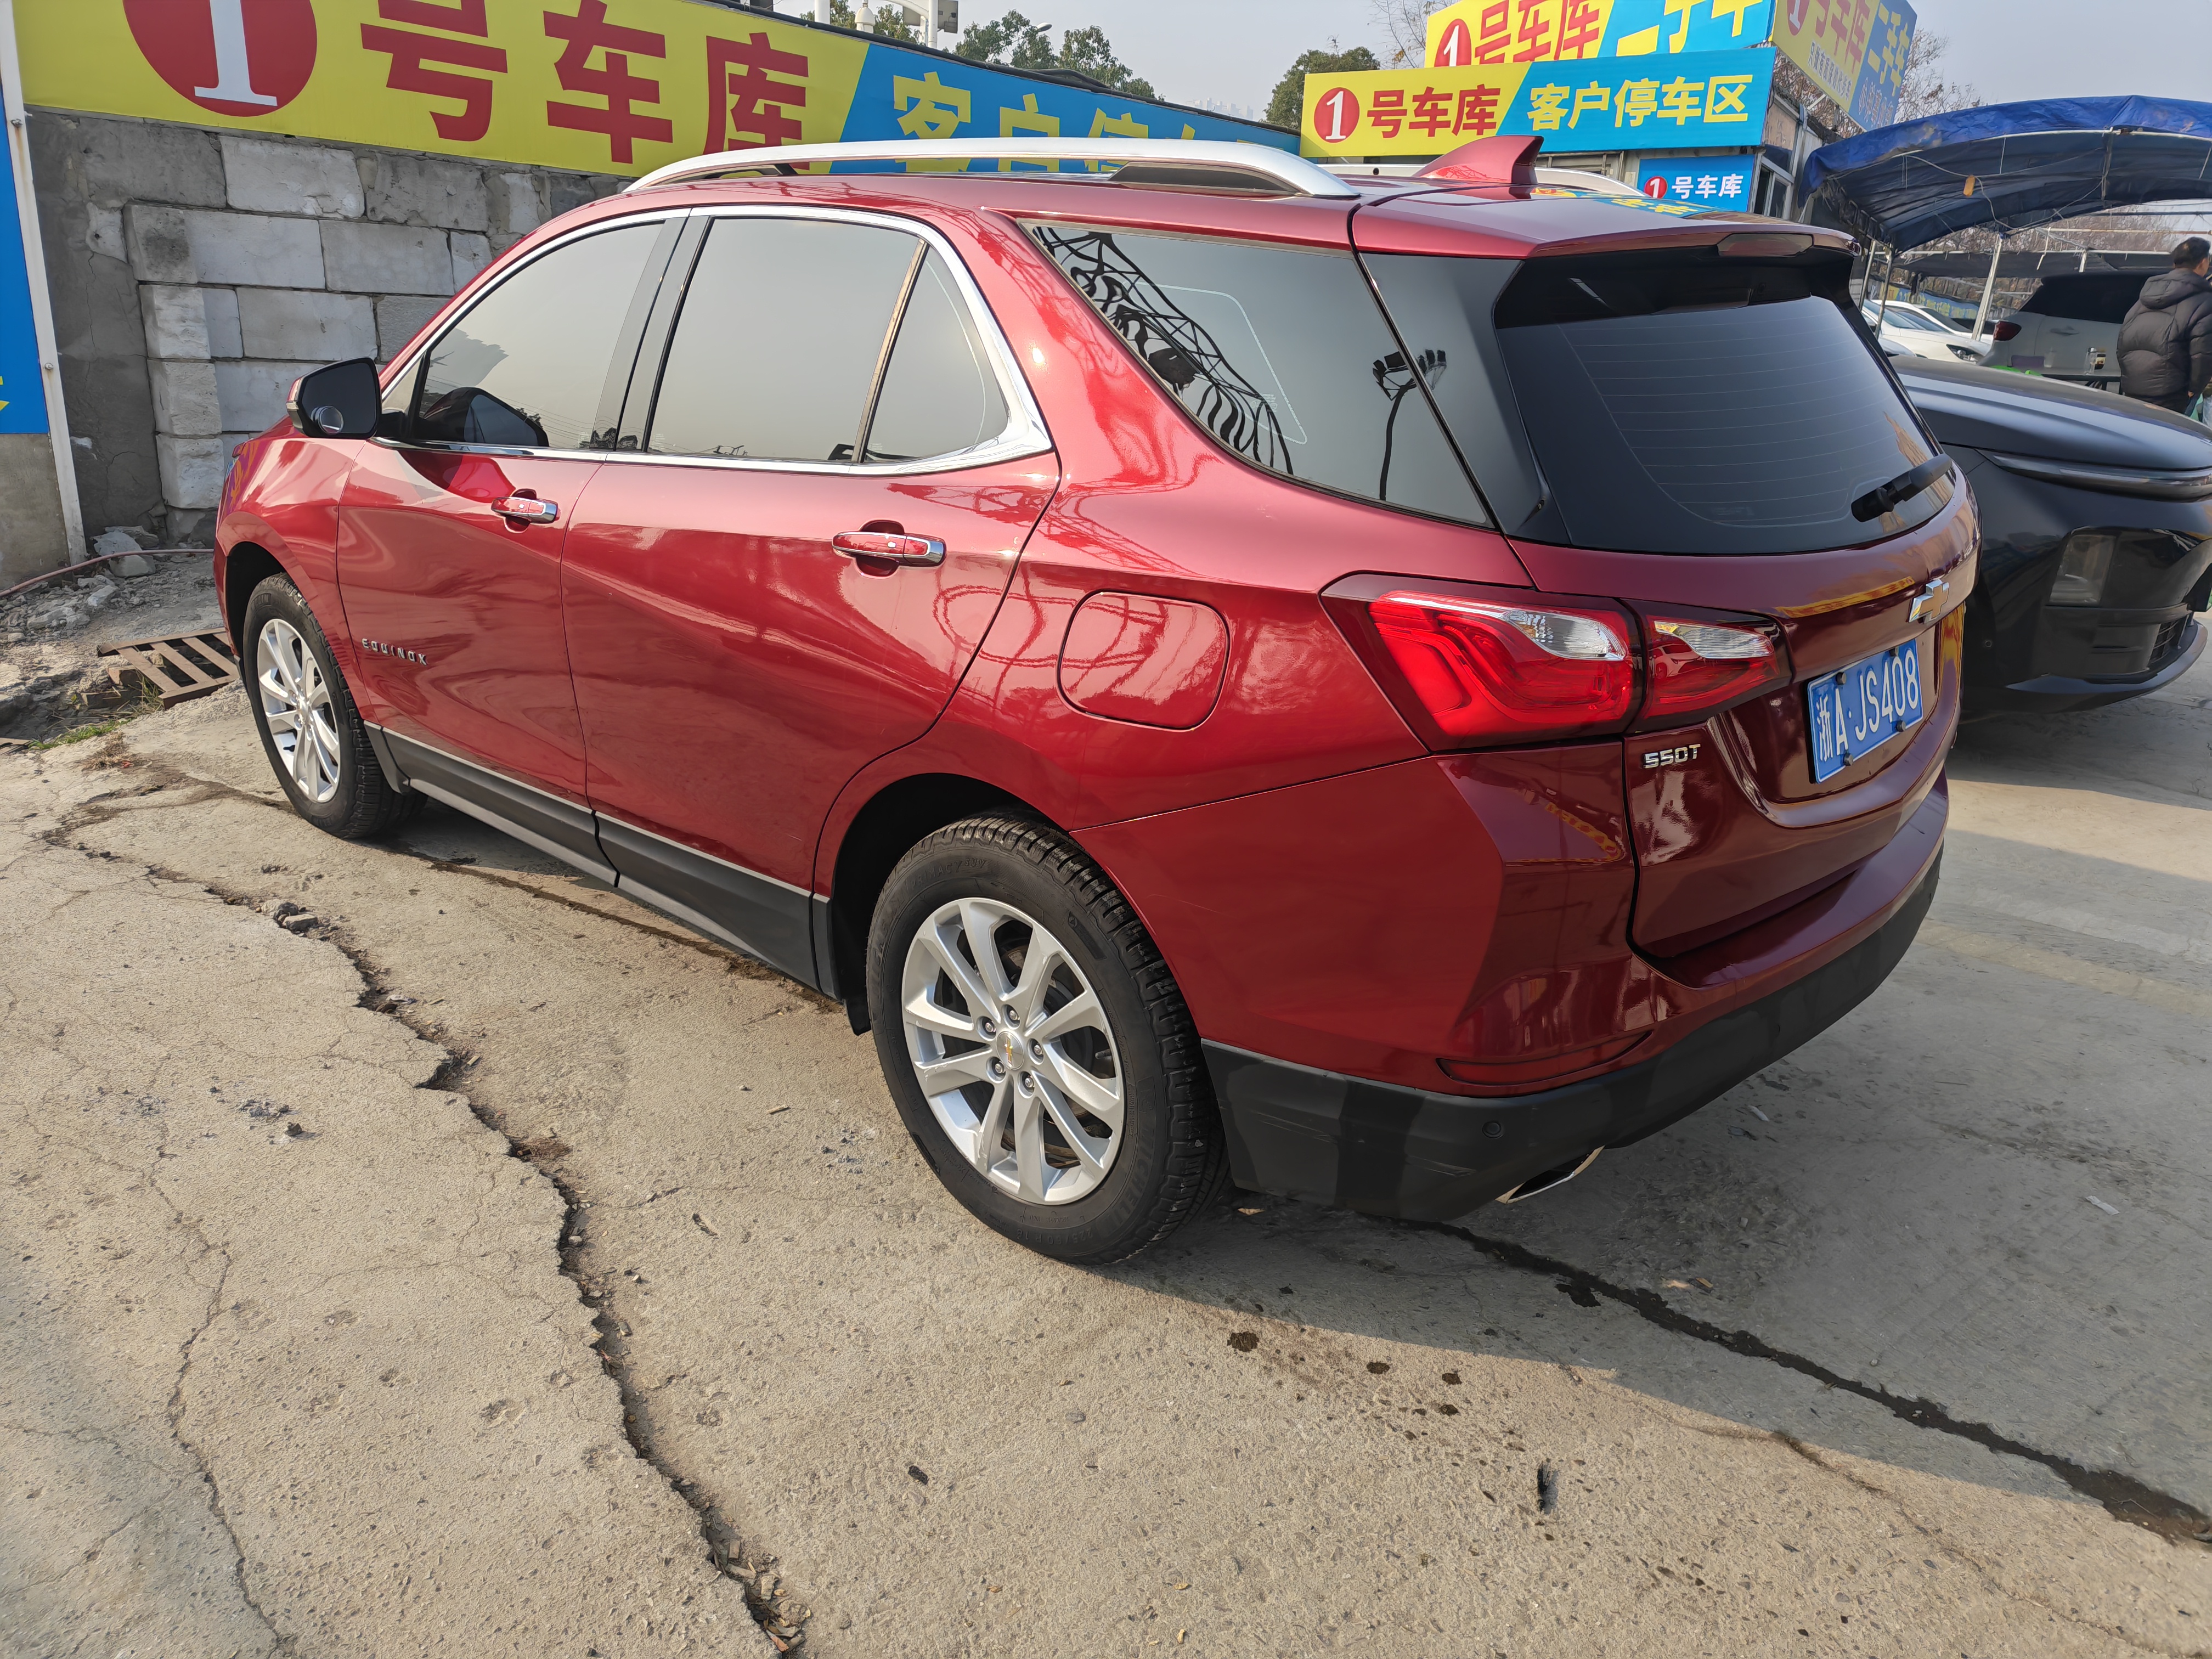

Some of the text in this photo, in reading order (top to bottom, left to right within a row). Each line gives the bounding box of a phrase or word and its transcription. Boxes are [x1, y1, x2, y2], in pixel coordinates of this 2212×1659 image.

[1868, 3, 1910, 97] 二手车
[1325, 75, 1753, 140] 1号车库 客户停车区
[1649, 173, 1743, 199] 1号车库
[362, 638, 428, 665] EQUINOX
[1643, 743, 1701, 769] 550T
[911, 860, 963, 890] PRIMACY
[964, 858, 986, 868] SUV
